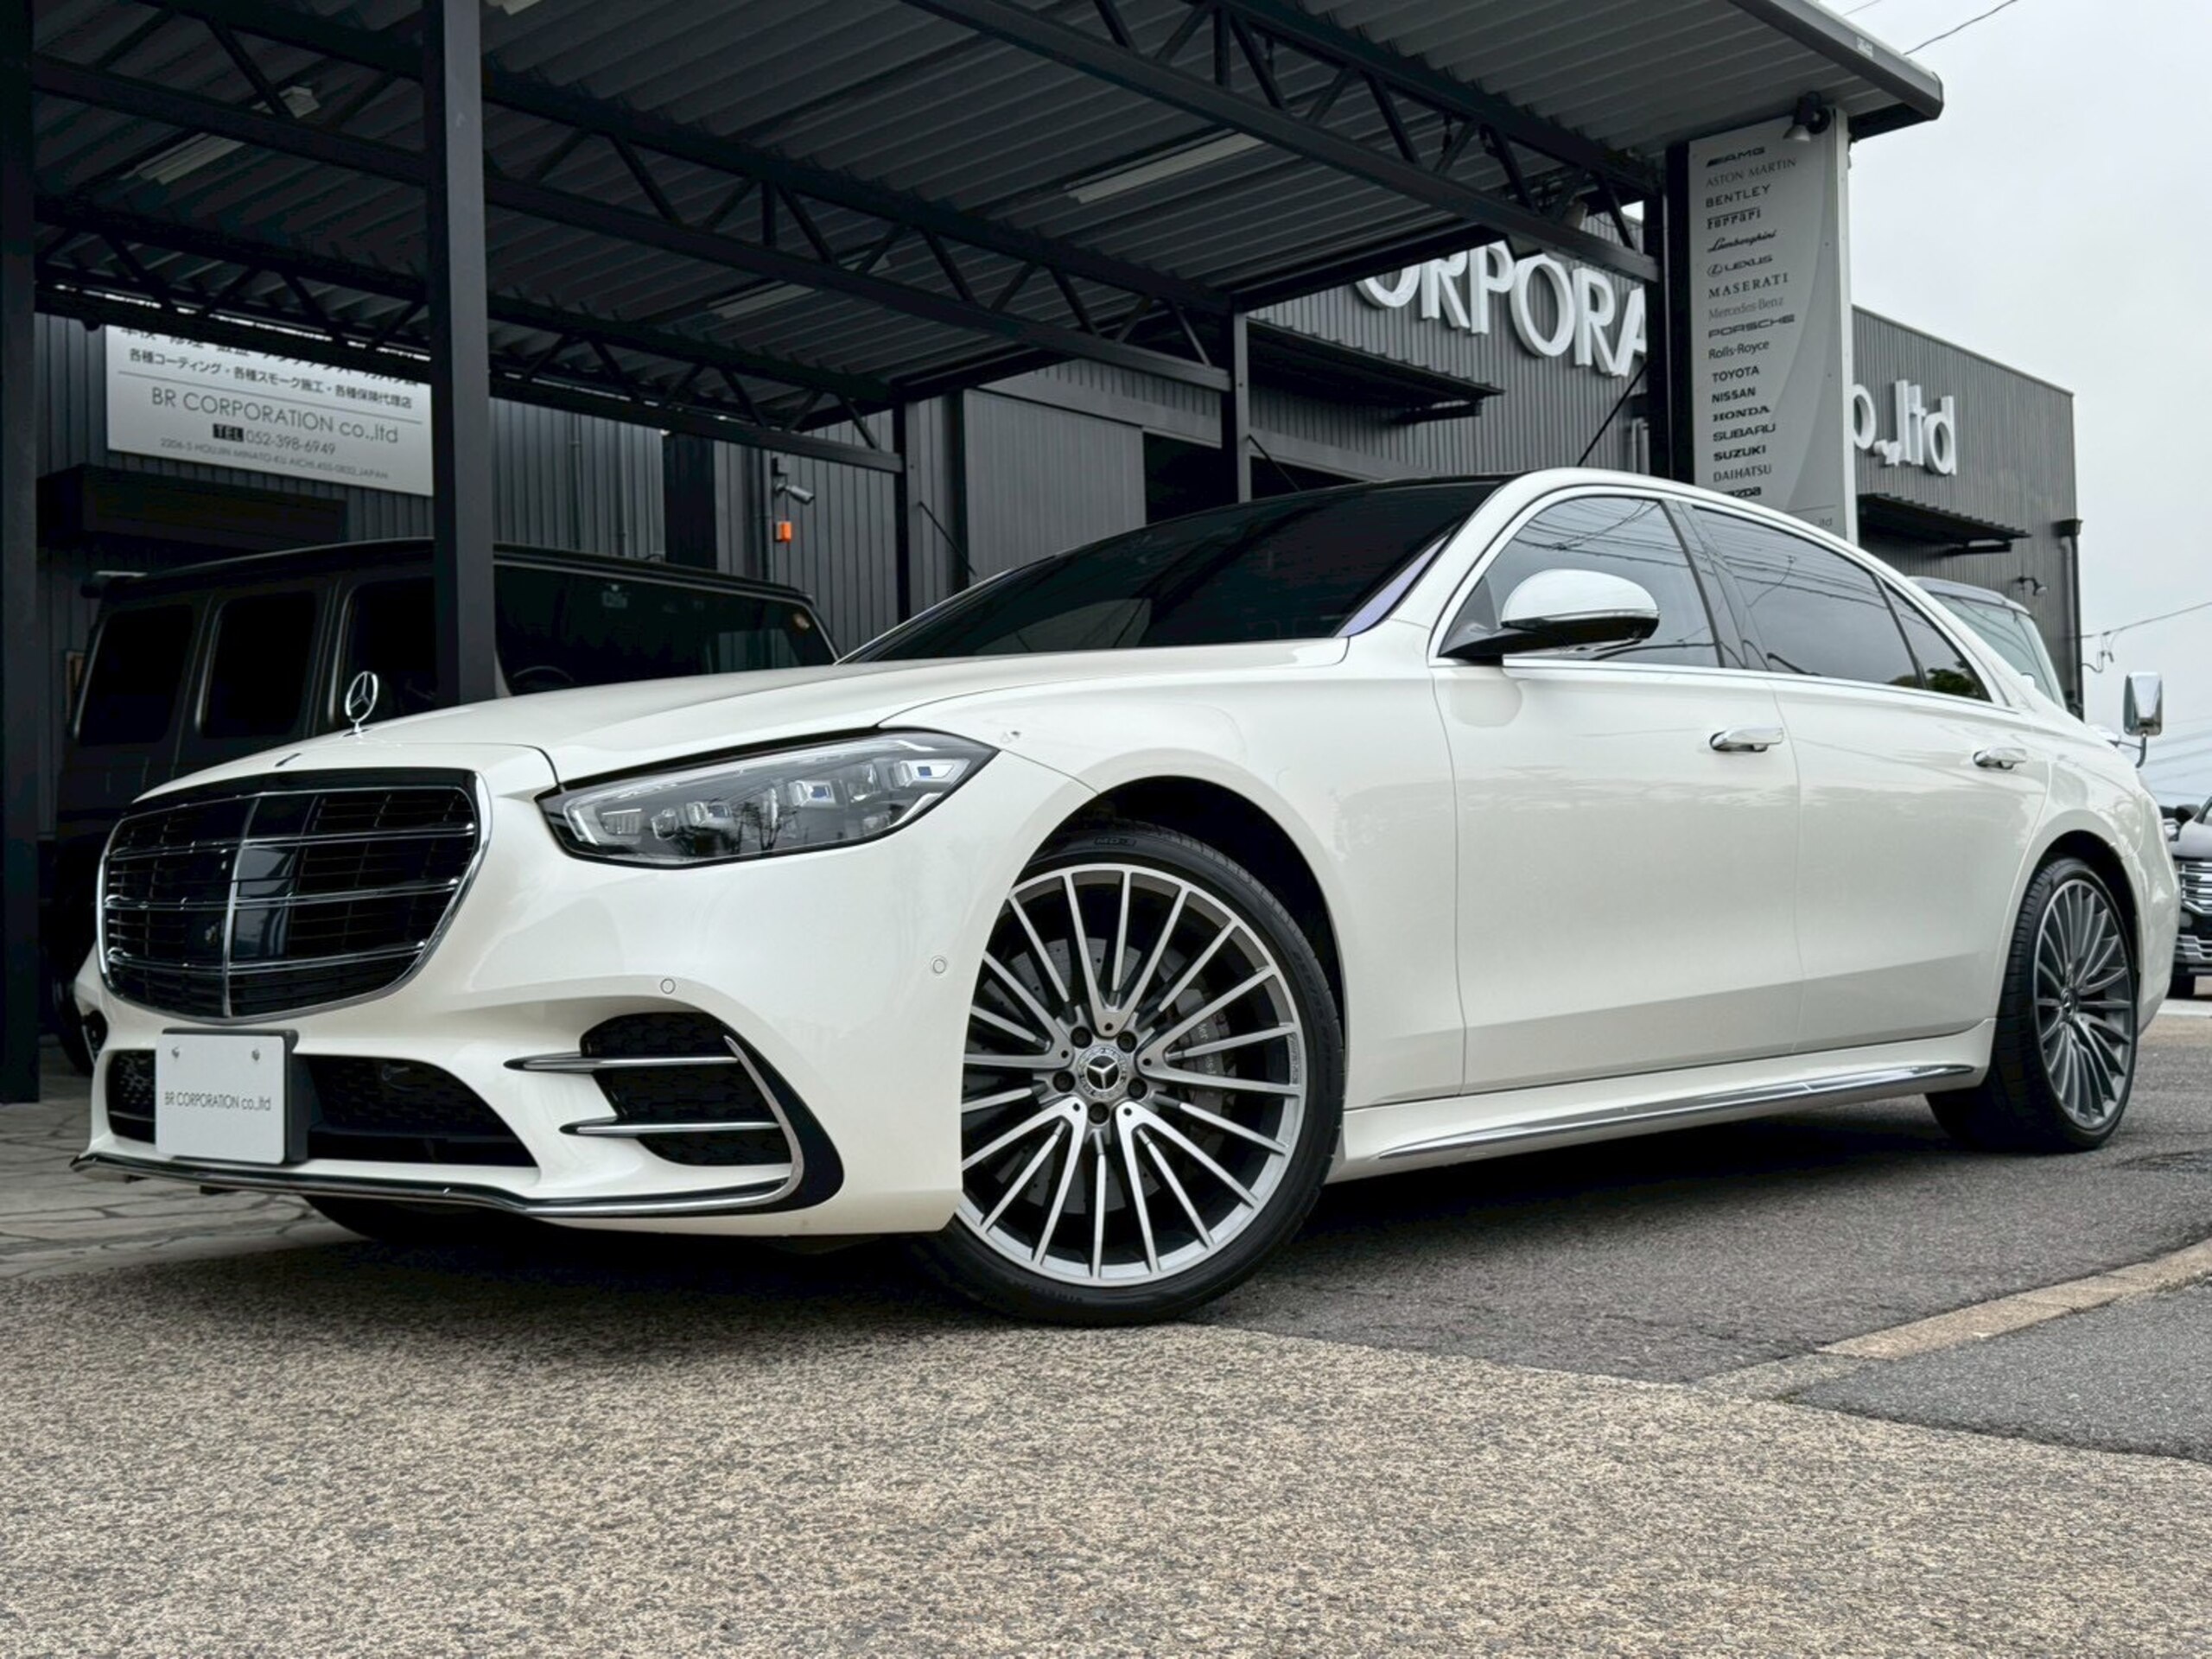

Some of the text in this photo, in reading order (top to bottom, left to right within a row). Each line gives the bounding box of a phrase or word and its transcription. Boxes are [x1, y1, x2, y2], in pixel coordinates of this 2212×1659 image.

[1706, 158, 1797, 188] ASTON MARTIN
[1706, 184, 1770, 208] BENTLEY
[1707, 207, 1761, 230] Ferrari
[1707, 230, 1777, 253] Lamborghini
[1725, 255, 1773, 271] LEXUS
[1708, 273, 1789, 299] MASERATI
[1708, 314, 1795, 339] PORSCHE
[1712, 365, 1760, 383] TOYOTA
[1712, 387, 1757, 404] NISSAN
[152, 387, 176, 408] BR
[183, 392, 334, 433] CORPORATION
[1713, 405, 1770, 422] HONDA
[215, 424, 336, 454] TEL 052-398-6949
[1713, 423, 1776, 442] SUBARU
[1713, 445, 1766, 461] SUZUKI
[1713, 463, 1771, 482] DAIHATSU
[164, 1091, 175, 1106] BR
[176, 1091, 239, 1109] CORPORATION
